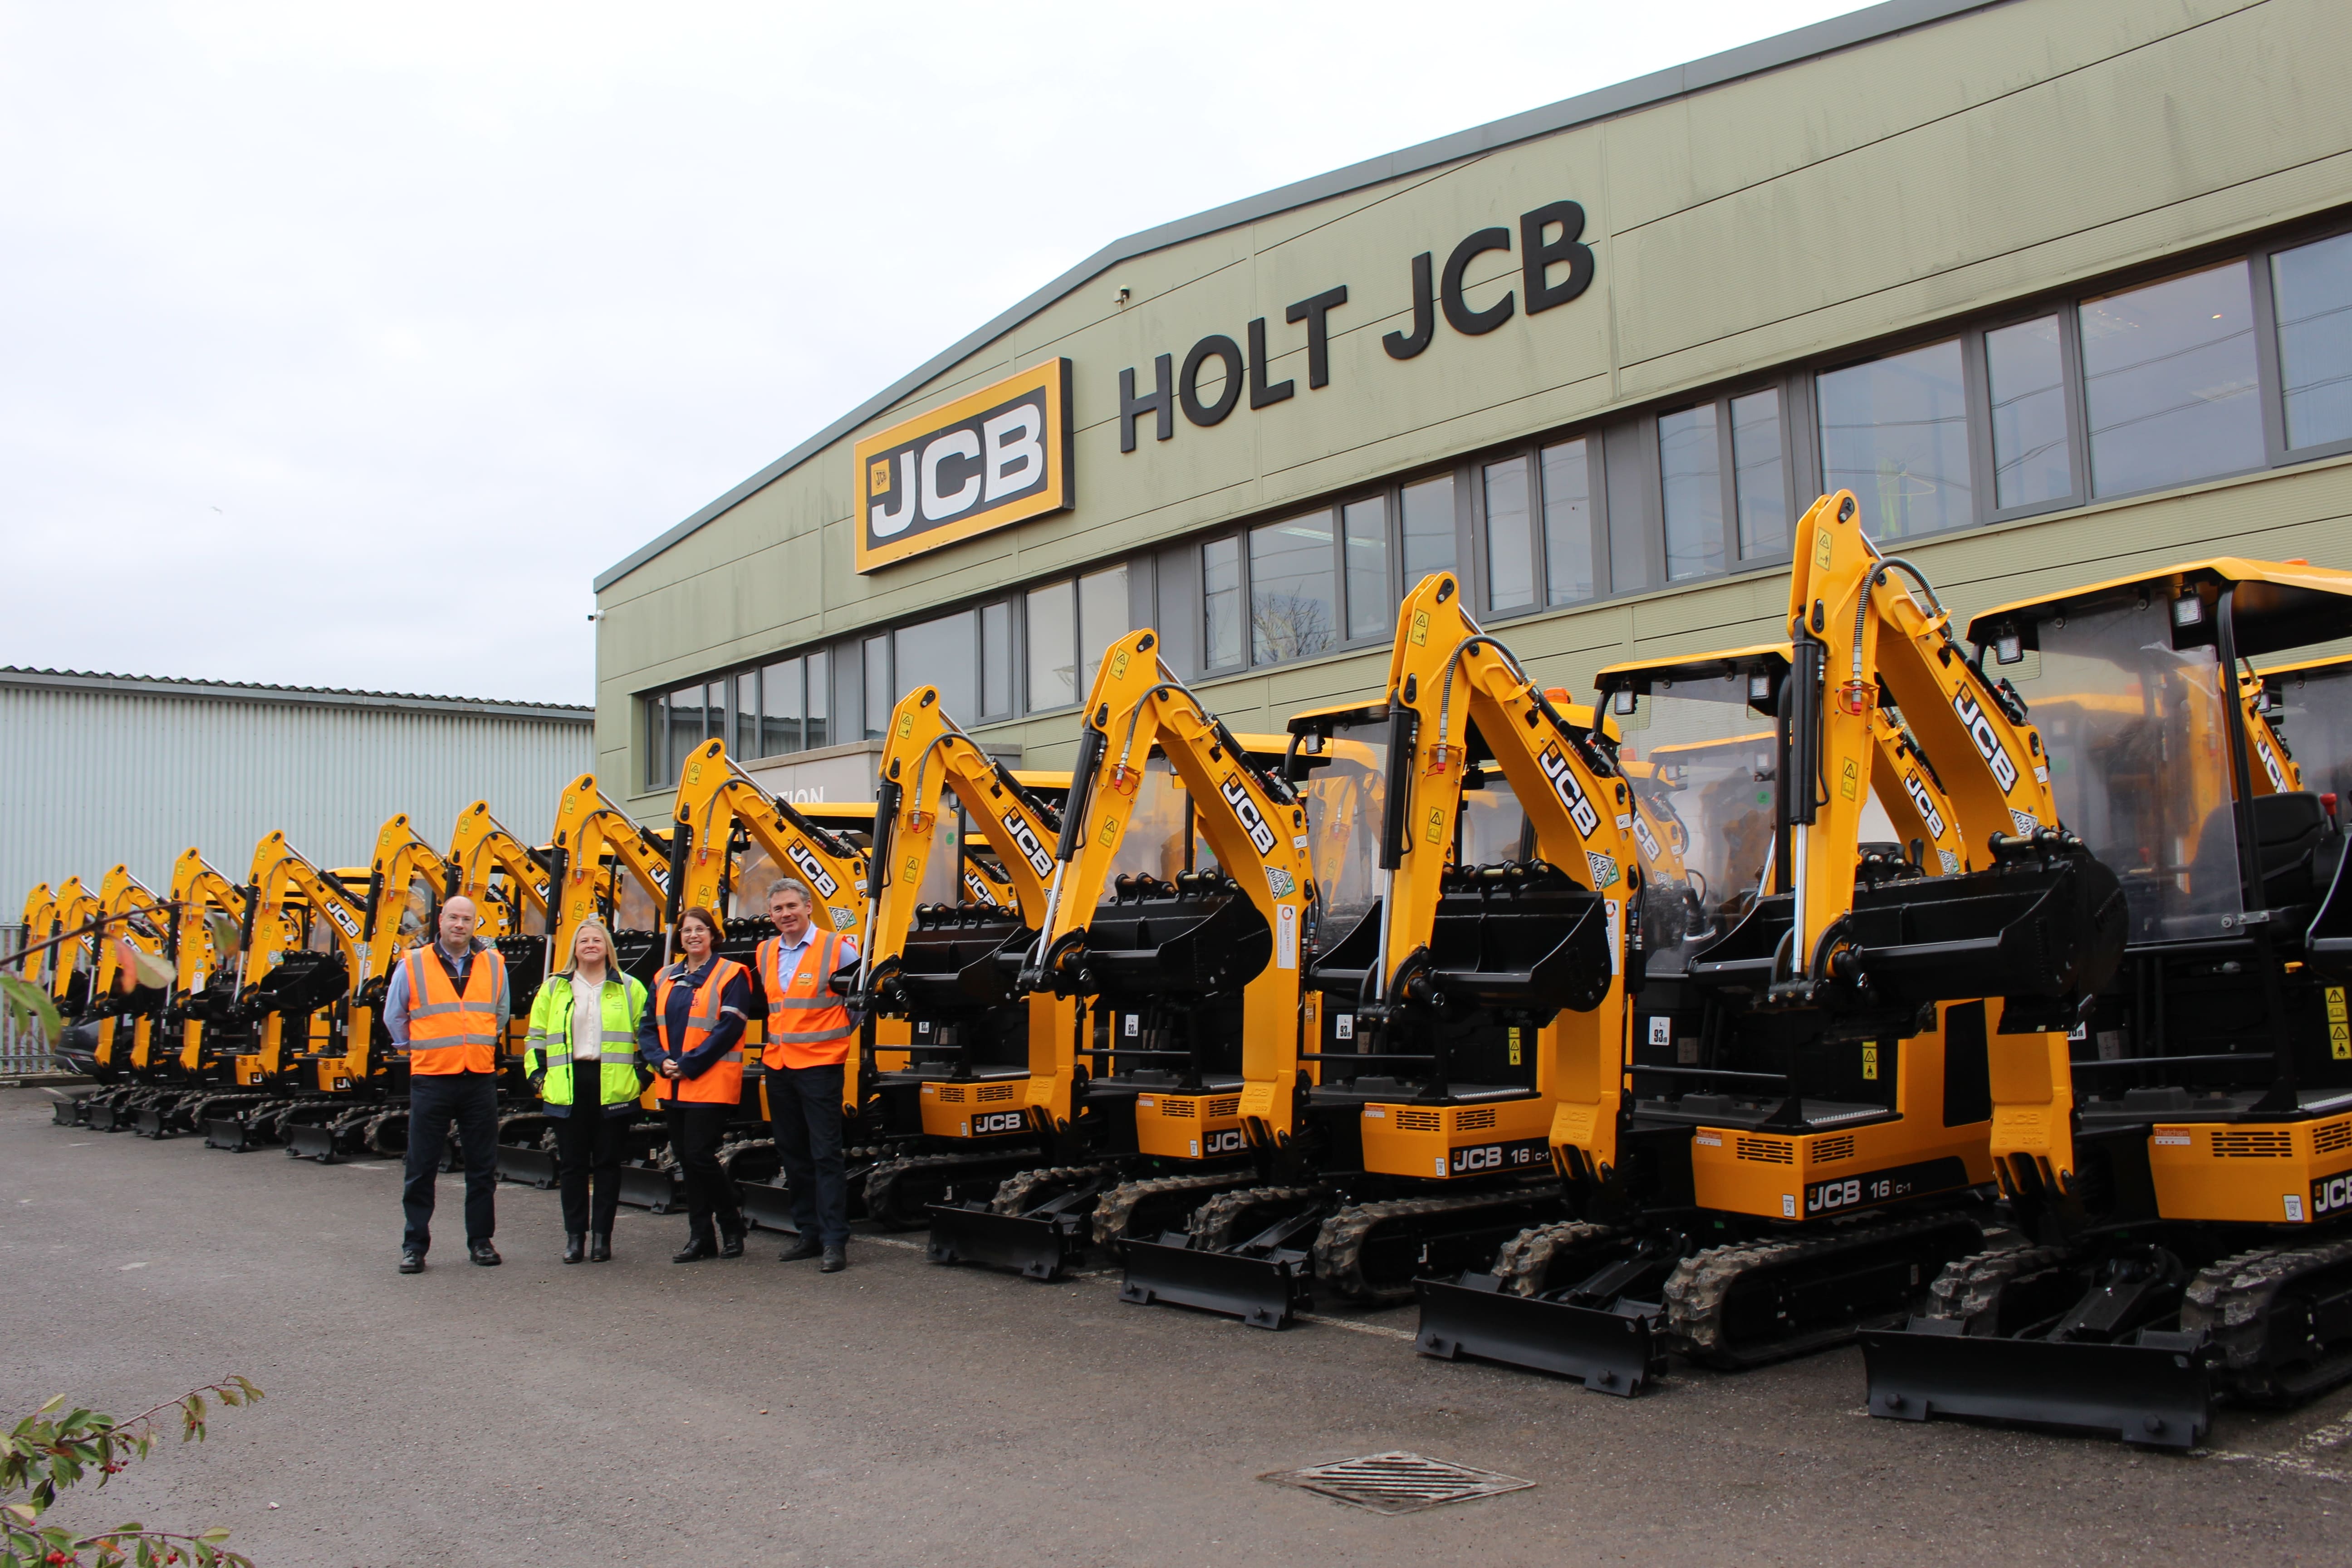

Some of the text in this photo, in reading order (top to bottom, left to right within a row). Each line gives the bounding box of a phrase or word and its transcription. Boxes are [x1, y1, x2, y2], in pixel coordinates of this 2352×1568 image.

[1119, 200, 1594, 452] HOLT JCB
[872, 403, 1044, 538] JCB
[1954, 696, 2016, 793] JCB
[1223, 781, 1274, 855] JCB
[1541, 752, 1597, 837] JCB
[1905, 777, 1944, 838] JCB
[1004, 814, 1053, 877] JCB
[1632, 810, 1659, 861] CB
[789, 846, 836, 898] JCB
[325, 902, 359, 938] JCB
[1654, 1029, 1663, 1043] 93
[975, 1113, 1021, 1133] JCB
[1453, 1147, 1502, 1171] JCB
[1511, 1148, 1529, 1164] 16
[1808, 1180, 1860, 1211] JCB
[1870, 1180, 1890, 1199] 16
